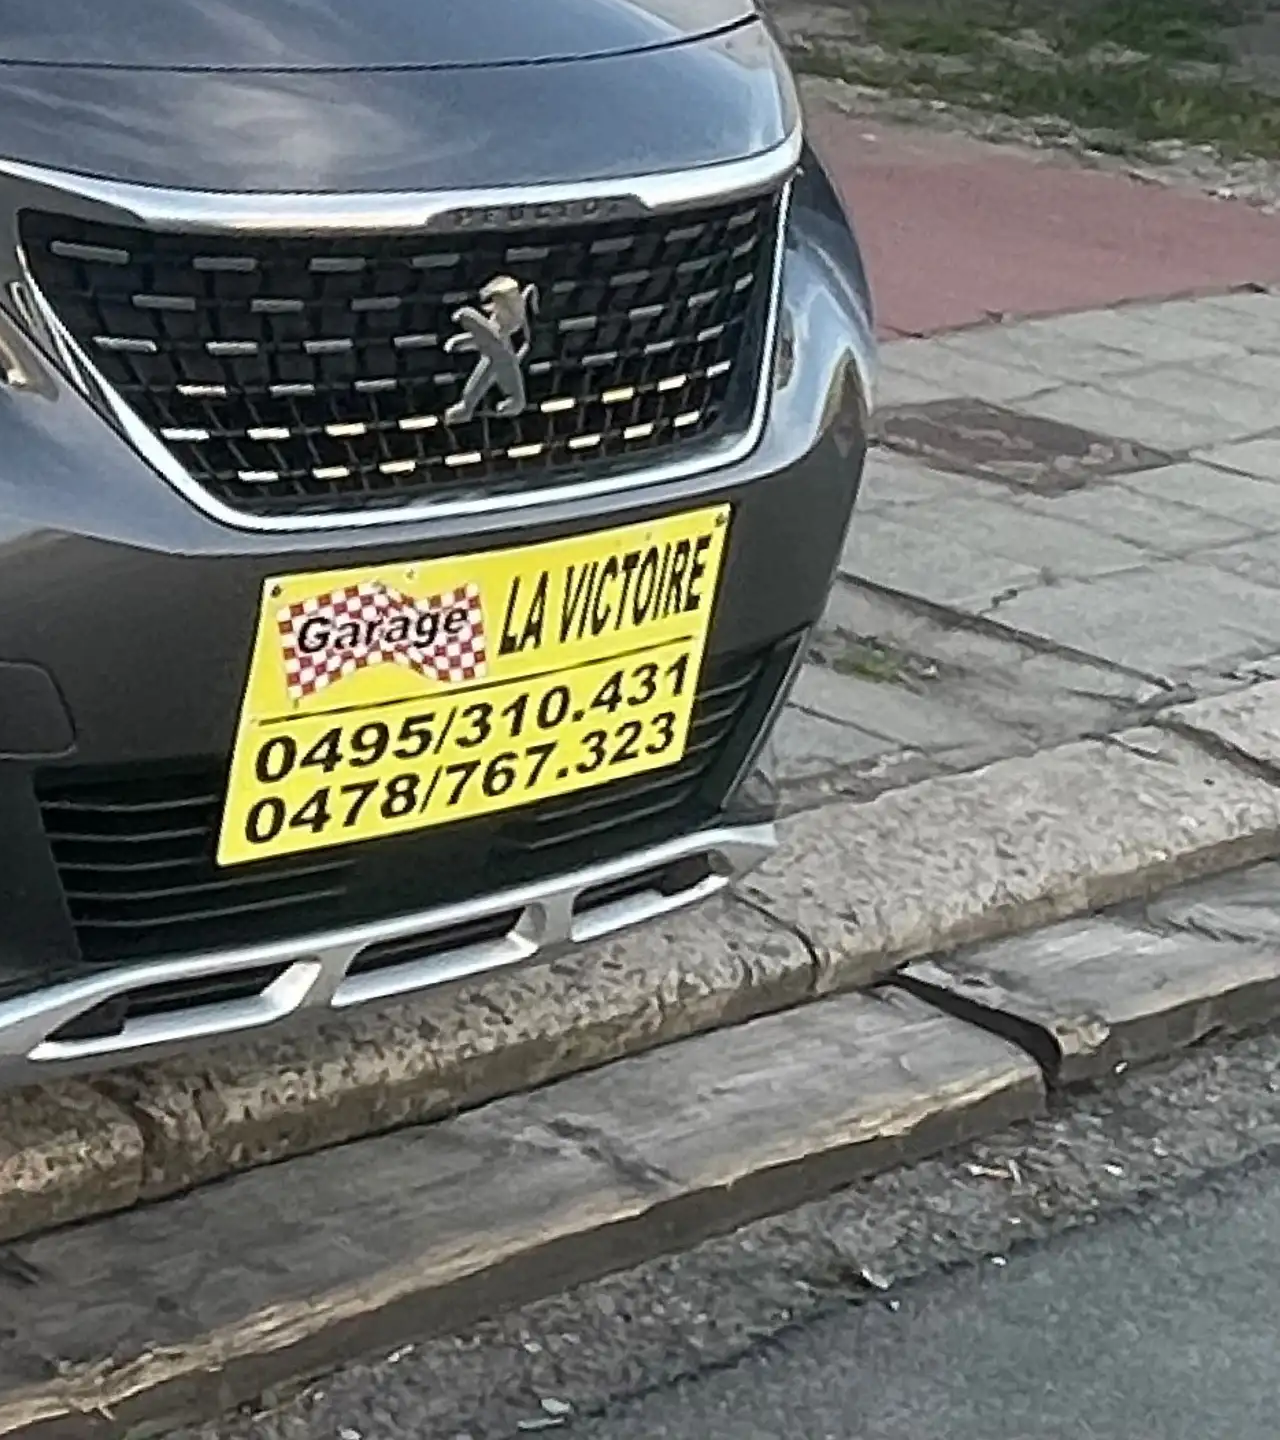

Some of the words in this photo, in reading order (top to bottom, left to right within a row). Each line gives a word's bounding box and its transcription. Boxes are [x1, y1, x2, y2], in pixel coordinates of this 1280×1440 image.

[297, 607, 468, 654] Garage
[498, 570, 549, 655] LA
[559, 533, 713, 643] VICTOIRE
[245, 711, 677, 844] 0478/767.323
[255, 652, 690, 784] 0495/310.431
